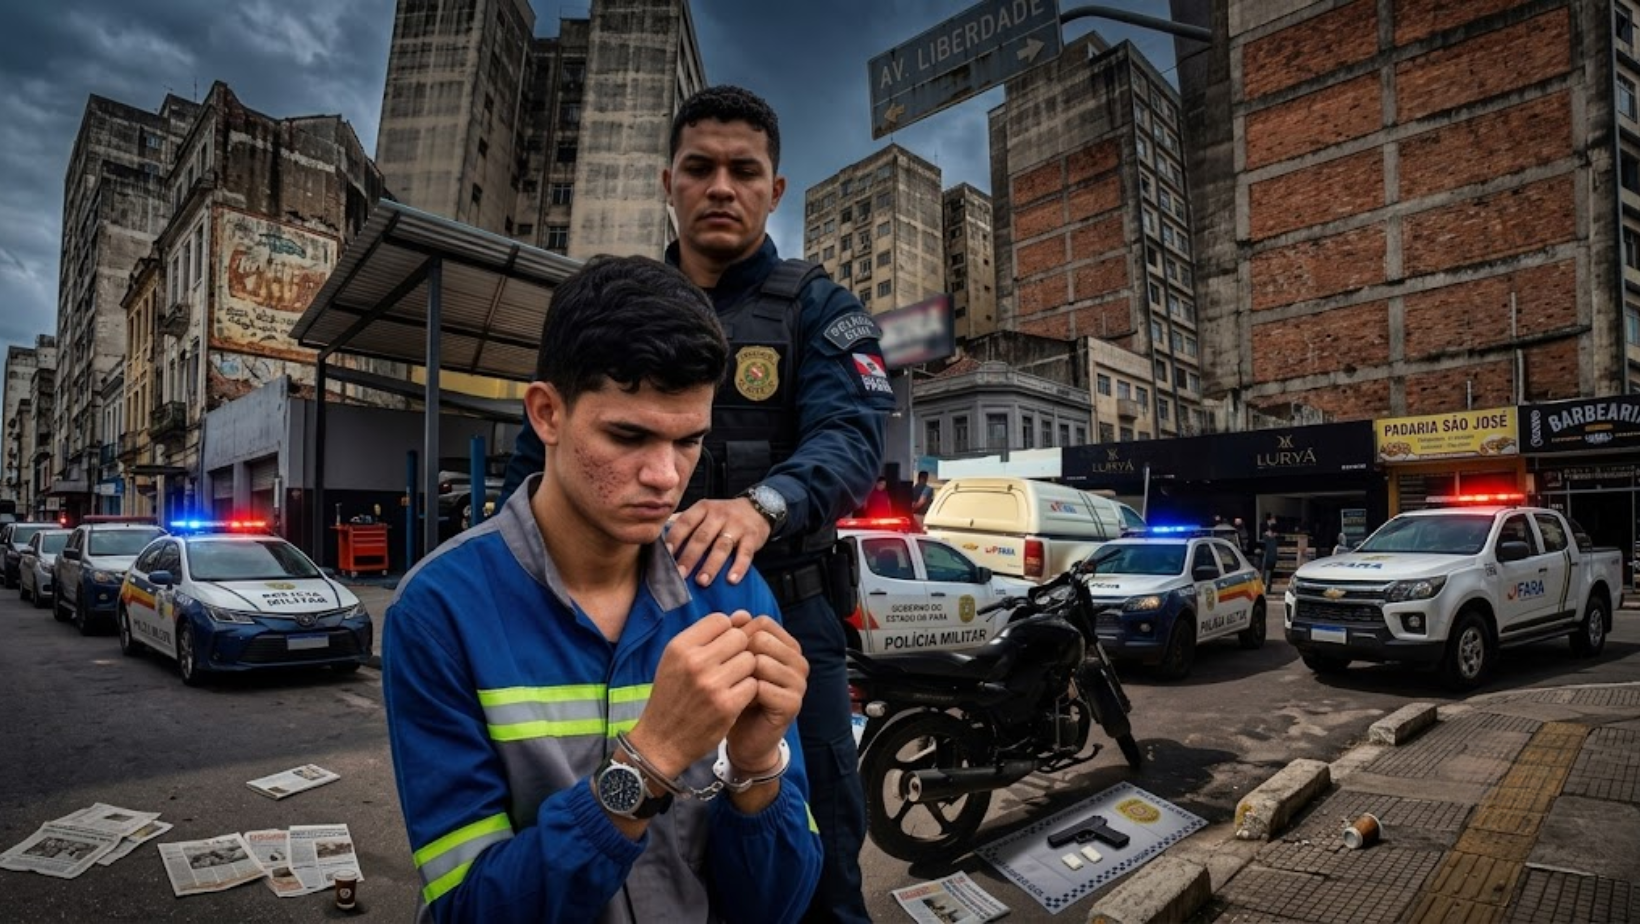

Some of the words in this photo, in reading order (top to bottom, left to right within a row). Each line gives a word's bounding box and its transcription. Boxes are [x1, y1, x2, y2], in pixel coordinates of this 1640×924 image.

[880, 58, 909, 89] AV.
[917, 0, 1045, 70] LIBERDADE
[1384, 420, 1438, 436] PADARIA
[1443, 414, 1468, 432] SÃO
[1473, 409, 1507, 430] JOSÉ
[1256, 448, 1316, 467] LURYÁ
[884, 631, 937, 650] POLÍCIA
[940, 629, 987, 645] MILITAR
